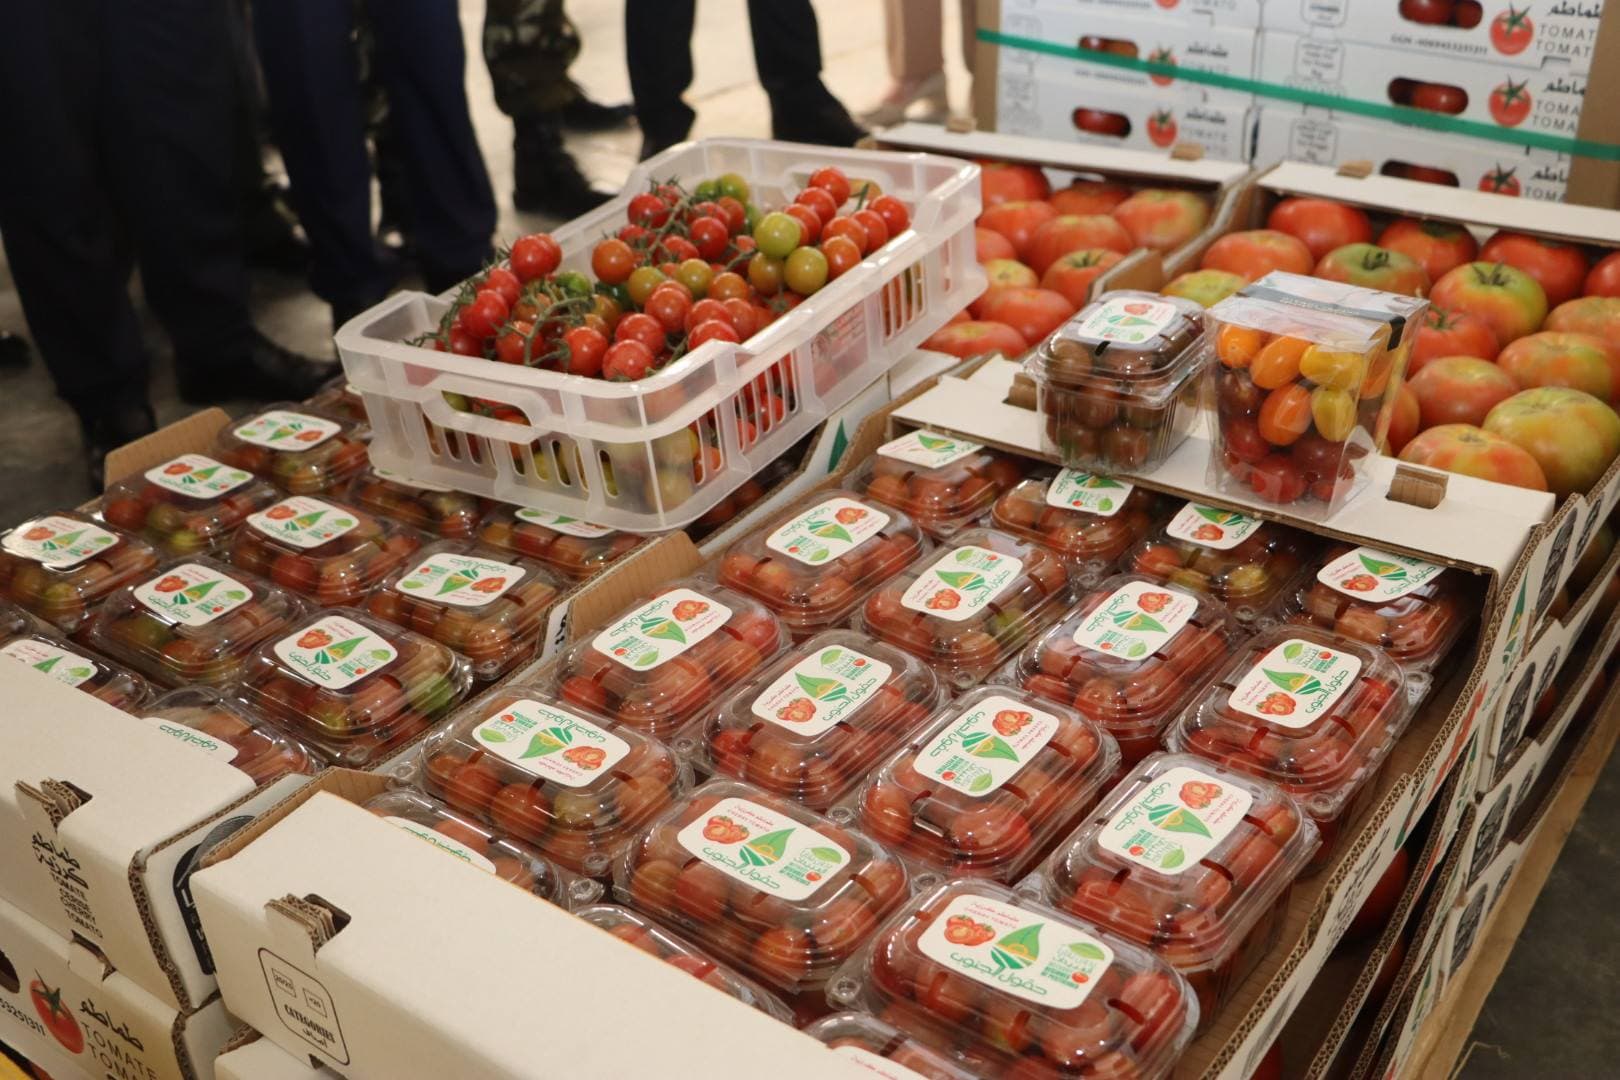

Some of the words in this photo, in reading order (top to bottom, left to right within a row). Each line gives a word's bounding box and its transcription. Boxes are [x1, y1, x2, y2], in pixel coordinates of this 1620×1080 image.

[1540, 23, 1595, 41] TOMAT
[1536, 39, 1592, 58] TOMAT
[1536, 99, 1580, 116] TOMA
[1532, 115, 1576, 132] TOMA
[1524, 184, 1567, 202] TOMA
